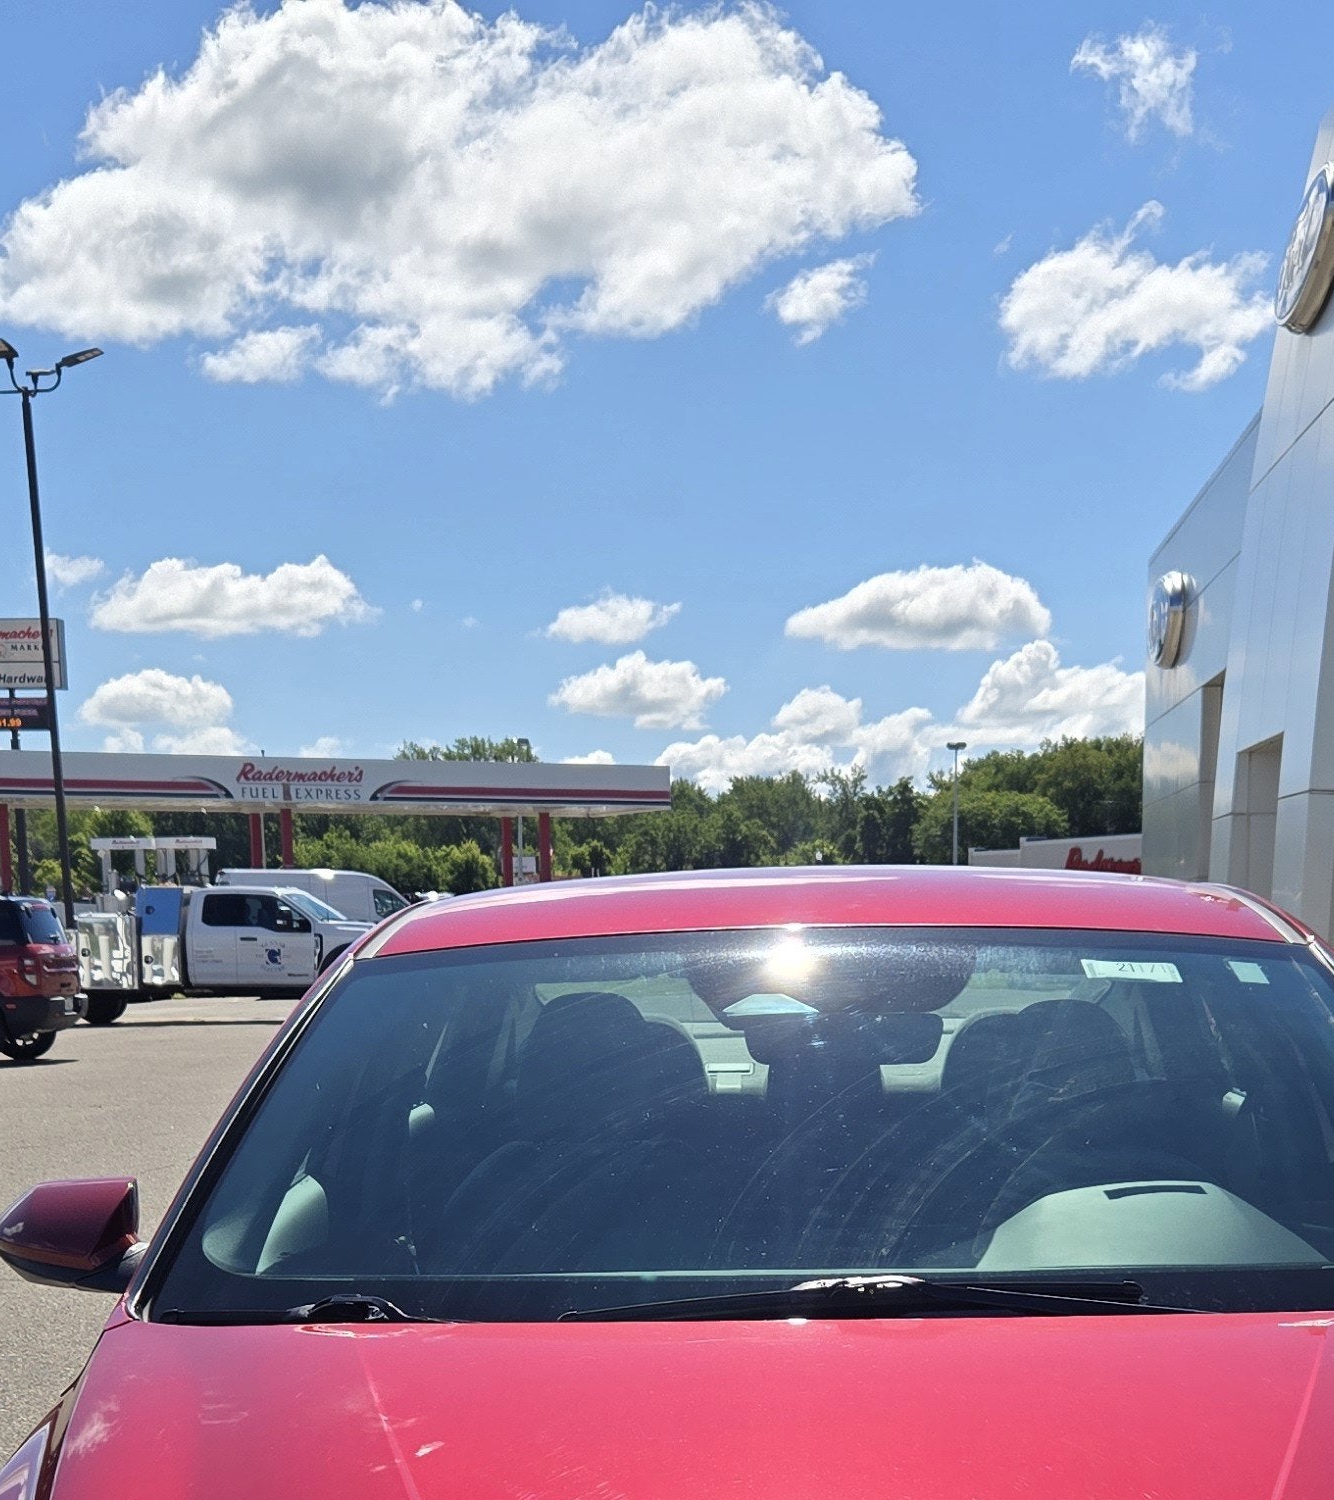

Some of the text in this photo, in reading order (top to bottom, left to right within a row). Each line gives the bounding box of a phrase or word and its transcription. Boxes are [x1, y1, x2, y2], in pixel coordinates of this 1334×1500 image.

[236, 762, 364, 783] Radermacher's
[241, 786, 361, 800] FUEL EXPRESS
